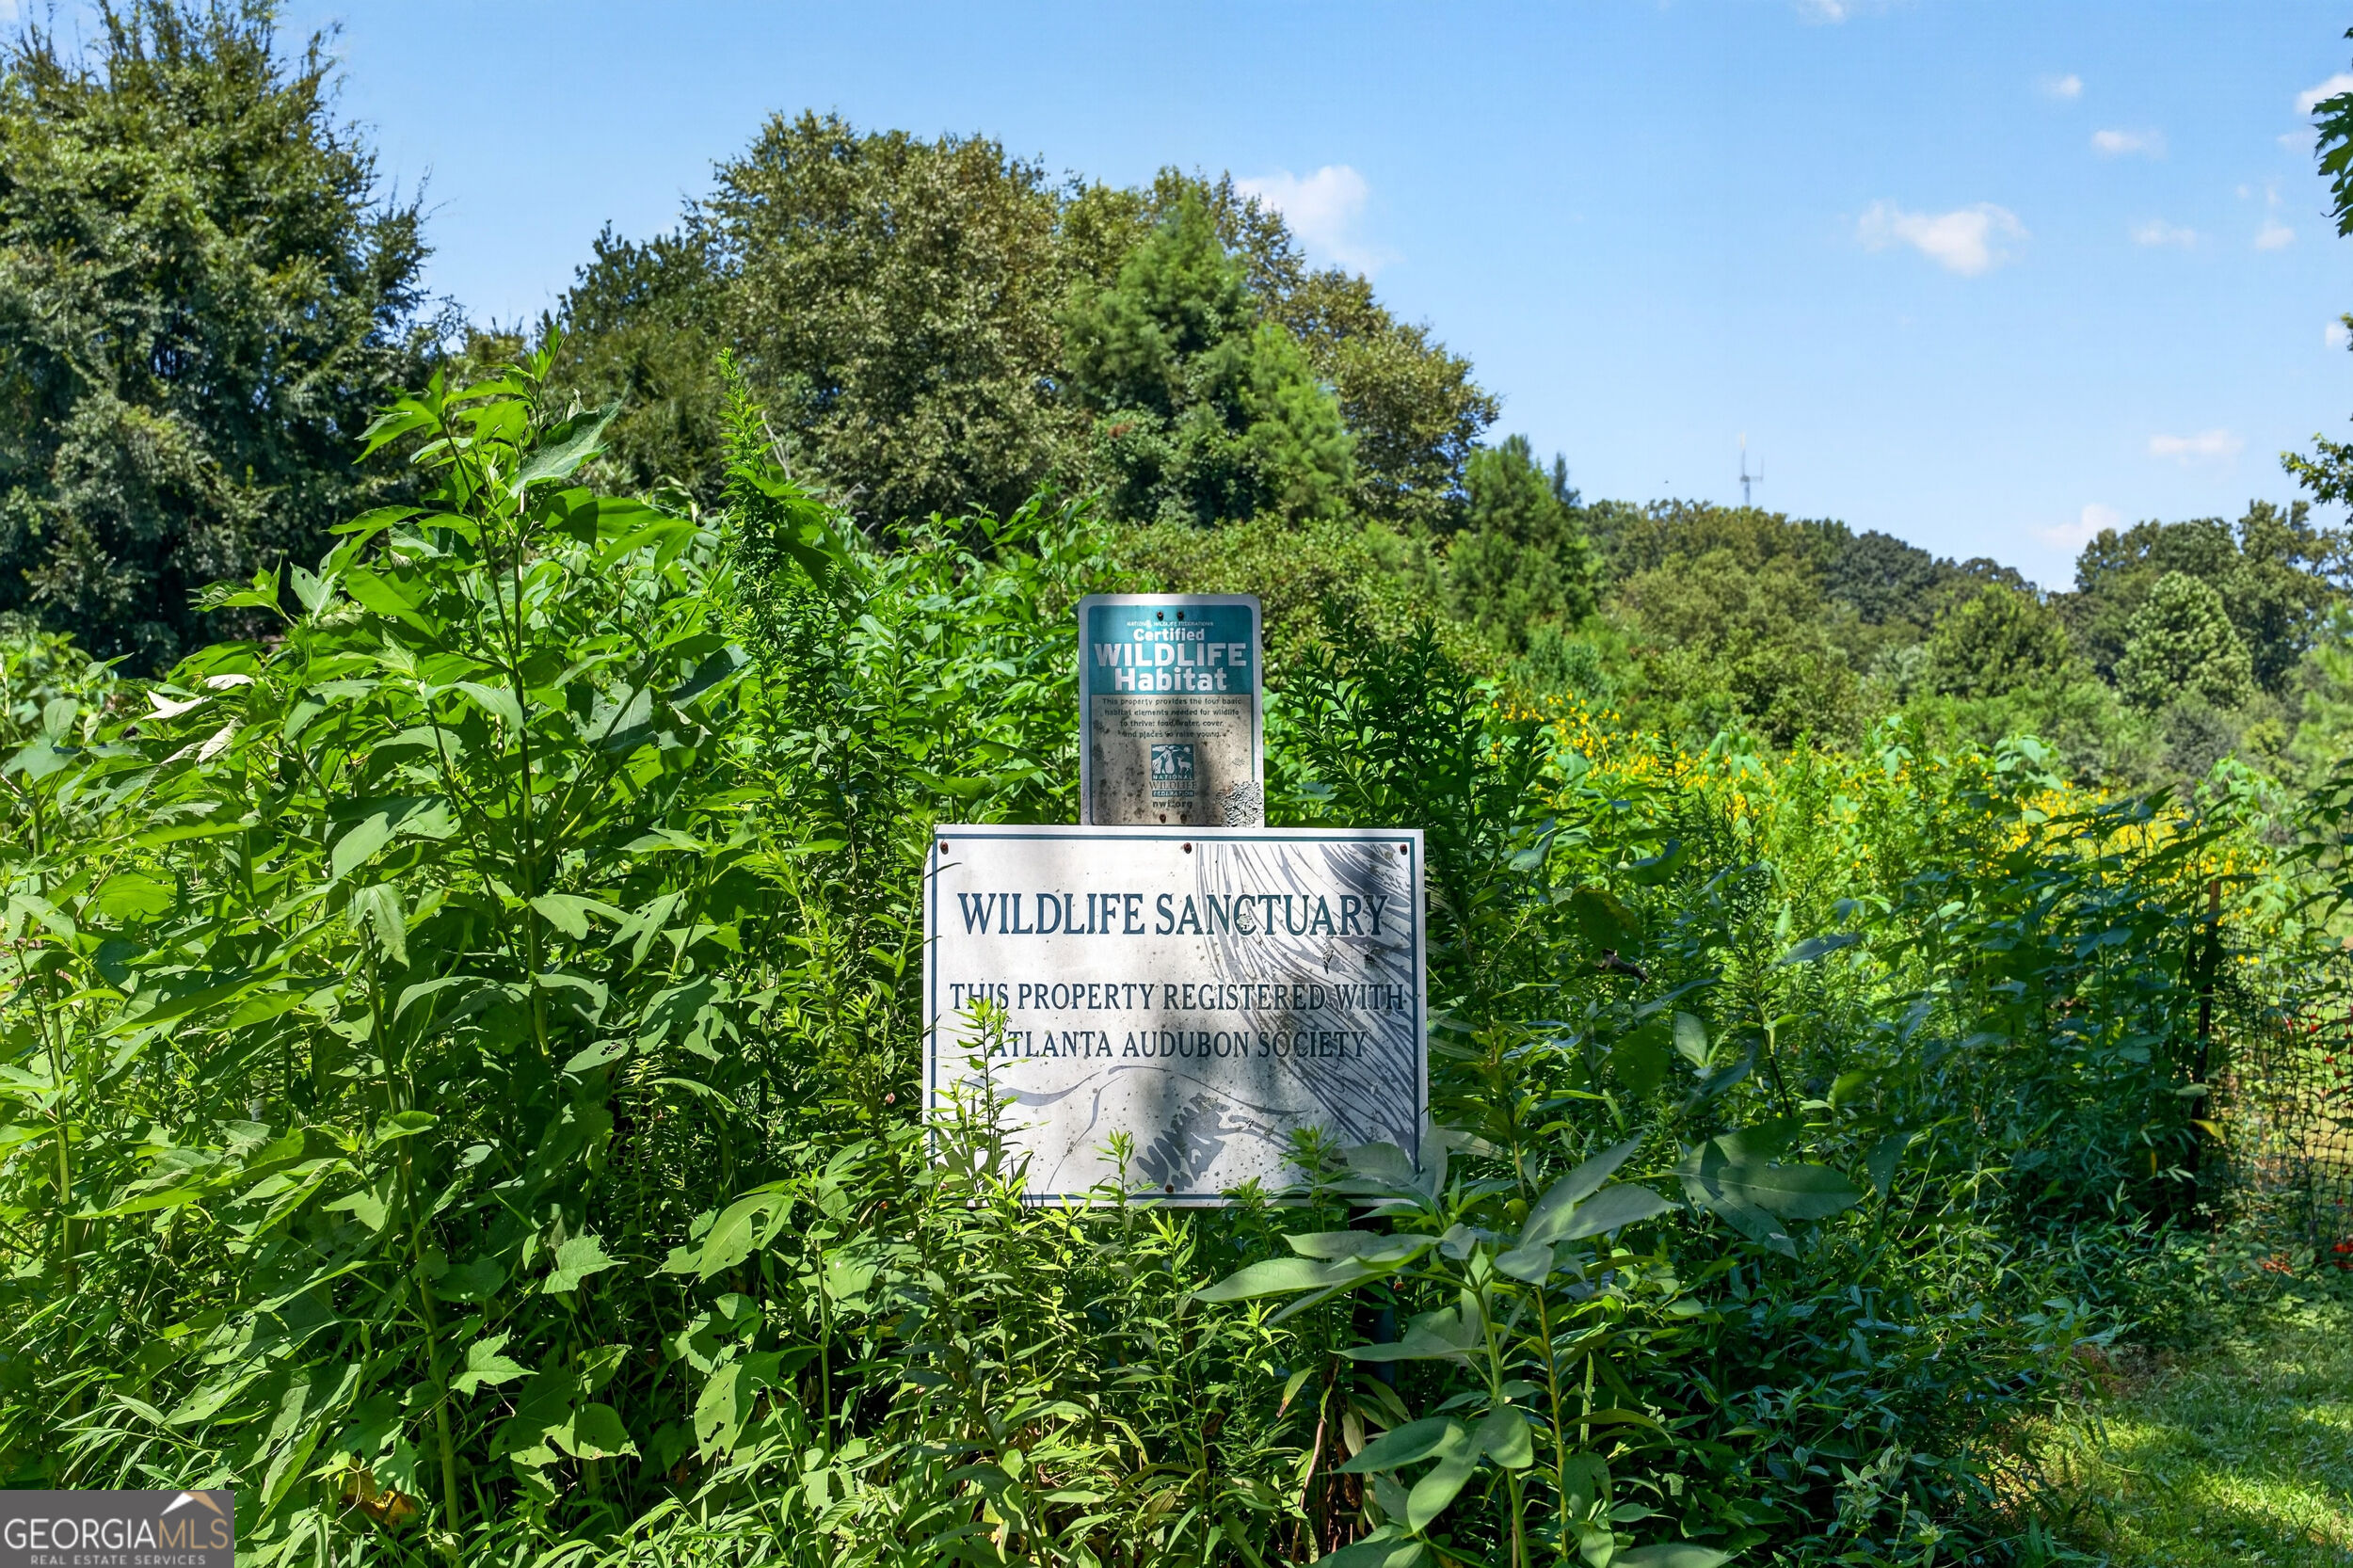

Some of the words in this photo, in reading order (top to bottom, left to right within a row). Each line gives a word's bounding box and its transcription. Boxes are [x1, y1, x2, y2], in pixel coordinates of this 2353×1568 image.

[1133, 628, 1205, 641] Certified
[1094, 643, 1247, 666] WILDLIFE
[1114, 666, 1227, 691] Habitat
[1155, 697, 1188, 706] provides
[1148, 780, 1197, 790] WILDLIFE
[958, 892, 1145, 936] WILDLIFE
[1155, 892, 1388, 936] SANCTUARY
[950, 983, 1009, 1011] THIS
[1017, 983, 1157, 1011] PROPERTY
[1163, 983, 1326, 1011] REGISTERED
[1334, 984, 1405, 1012] WITH
[1122, 1031, 1251, 1058] AUDUBON
[1257, 1031, 1369, 1059] SOCIETY
